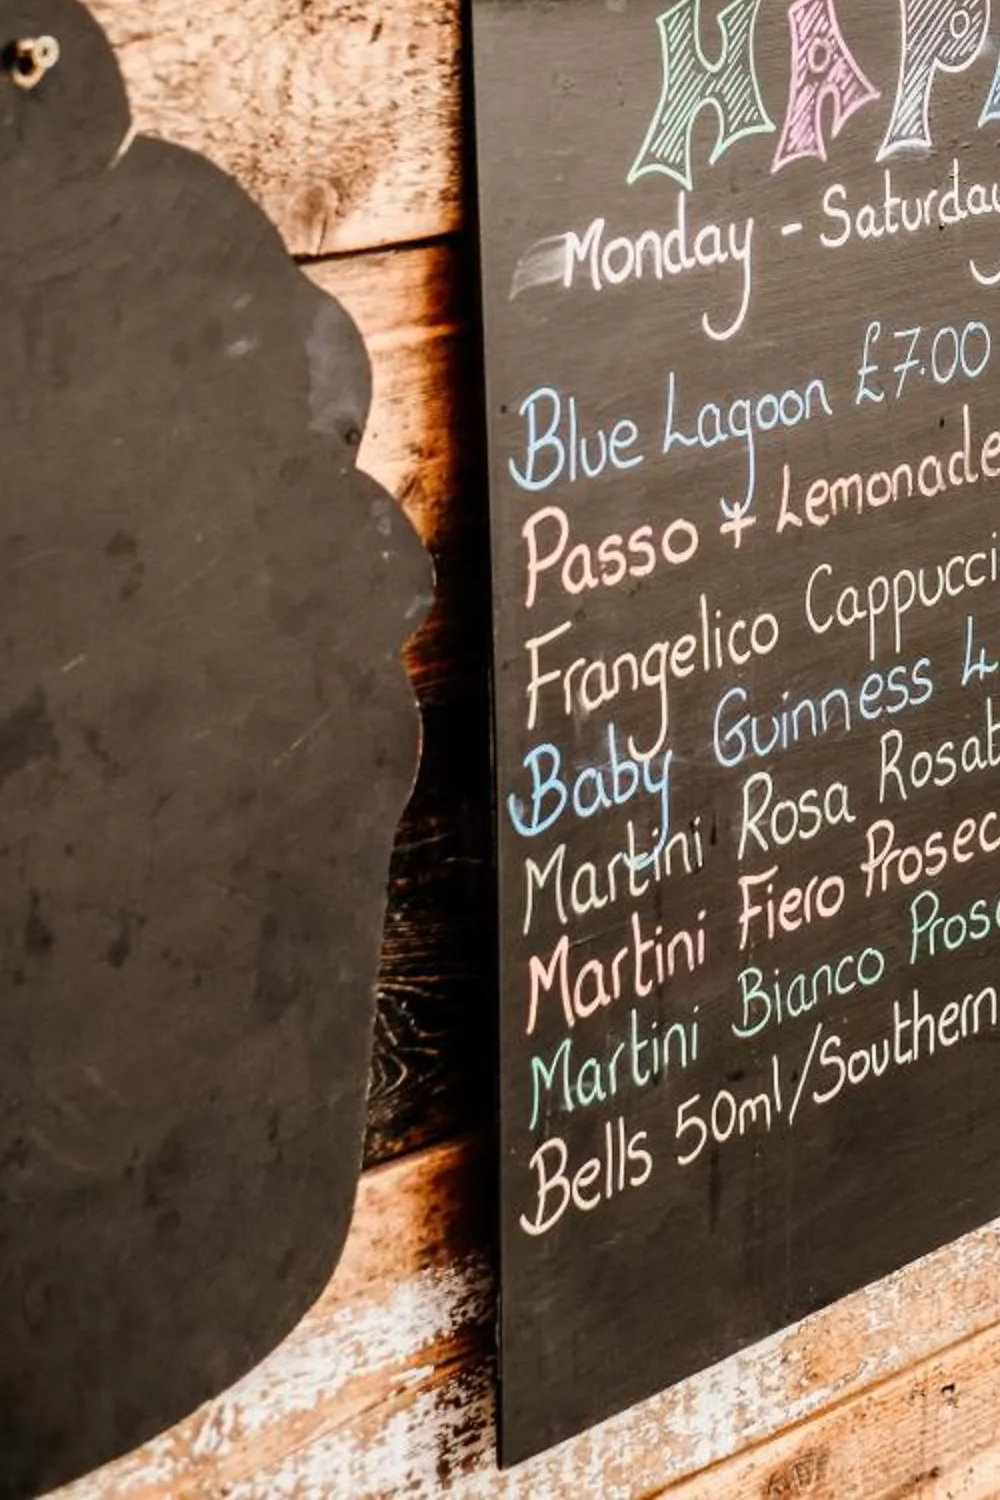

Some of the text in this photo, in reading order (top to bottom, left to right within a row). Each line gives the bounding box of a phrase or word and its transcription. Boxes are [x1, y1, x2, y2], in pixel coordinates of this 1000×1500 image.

[562, 189, 754, 342] Monday
[508, 320, 992, 520] Blue Lagoon £7.00
[521, 505, 700, 610] Passo
[719, 502, 758, 550] +
[507, 722, 674, 871] Baby
[712, 658, 934, 769] Guinness
[960, 615, 999, 687] 4
[524, 593, 780, 763] Frangelico
[522, 815, 705, 936] Martini
[736, 770, 857, 861] Rosa
[525, 909, 708, 1036] Martini
[736, 864, 846, 952] Fiero
[528, 1004, 701, 1132] Martini
[731, 946, 886, 1039] Bianco
[519, 1114, 654, 1237] Bells
